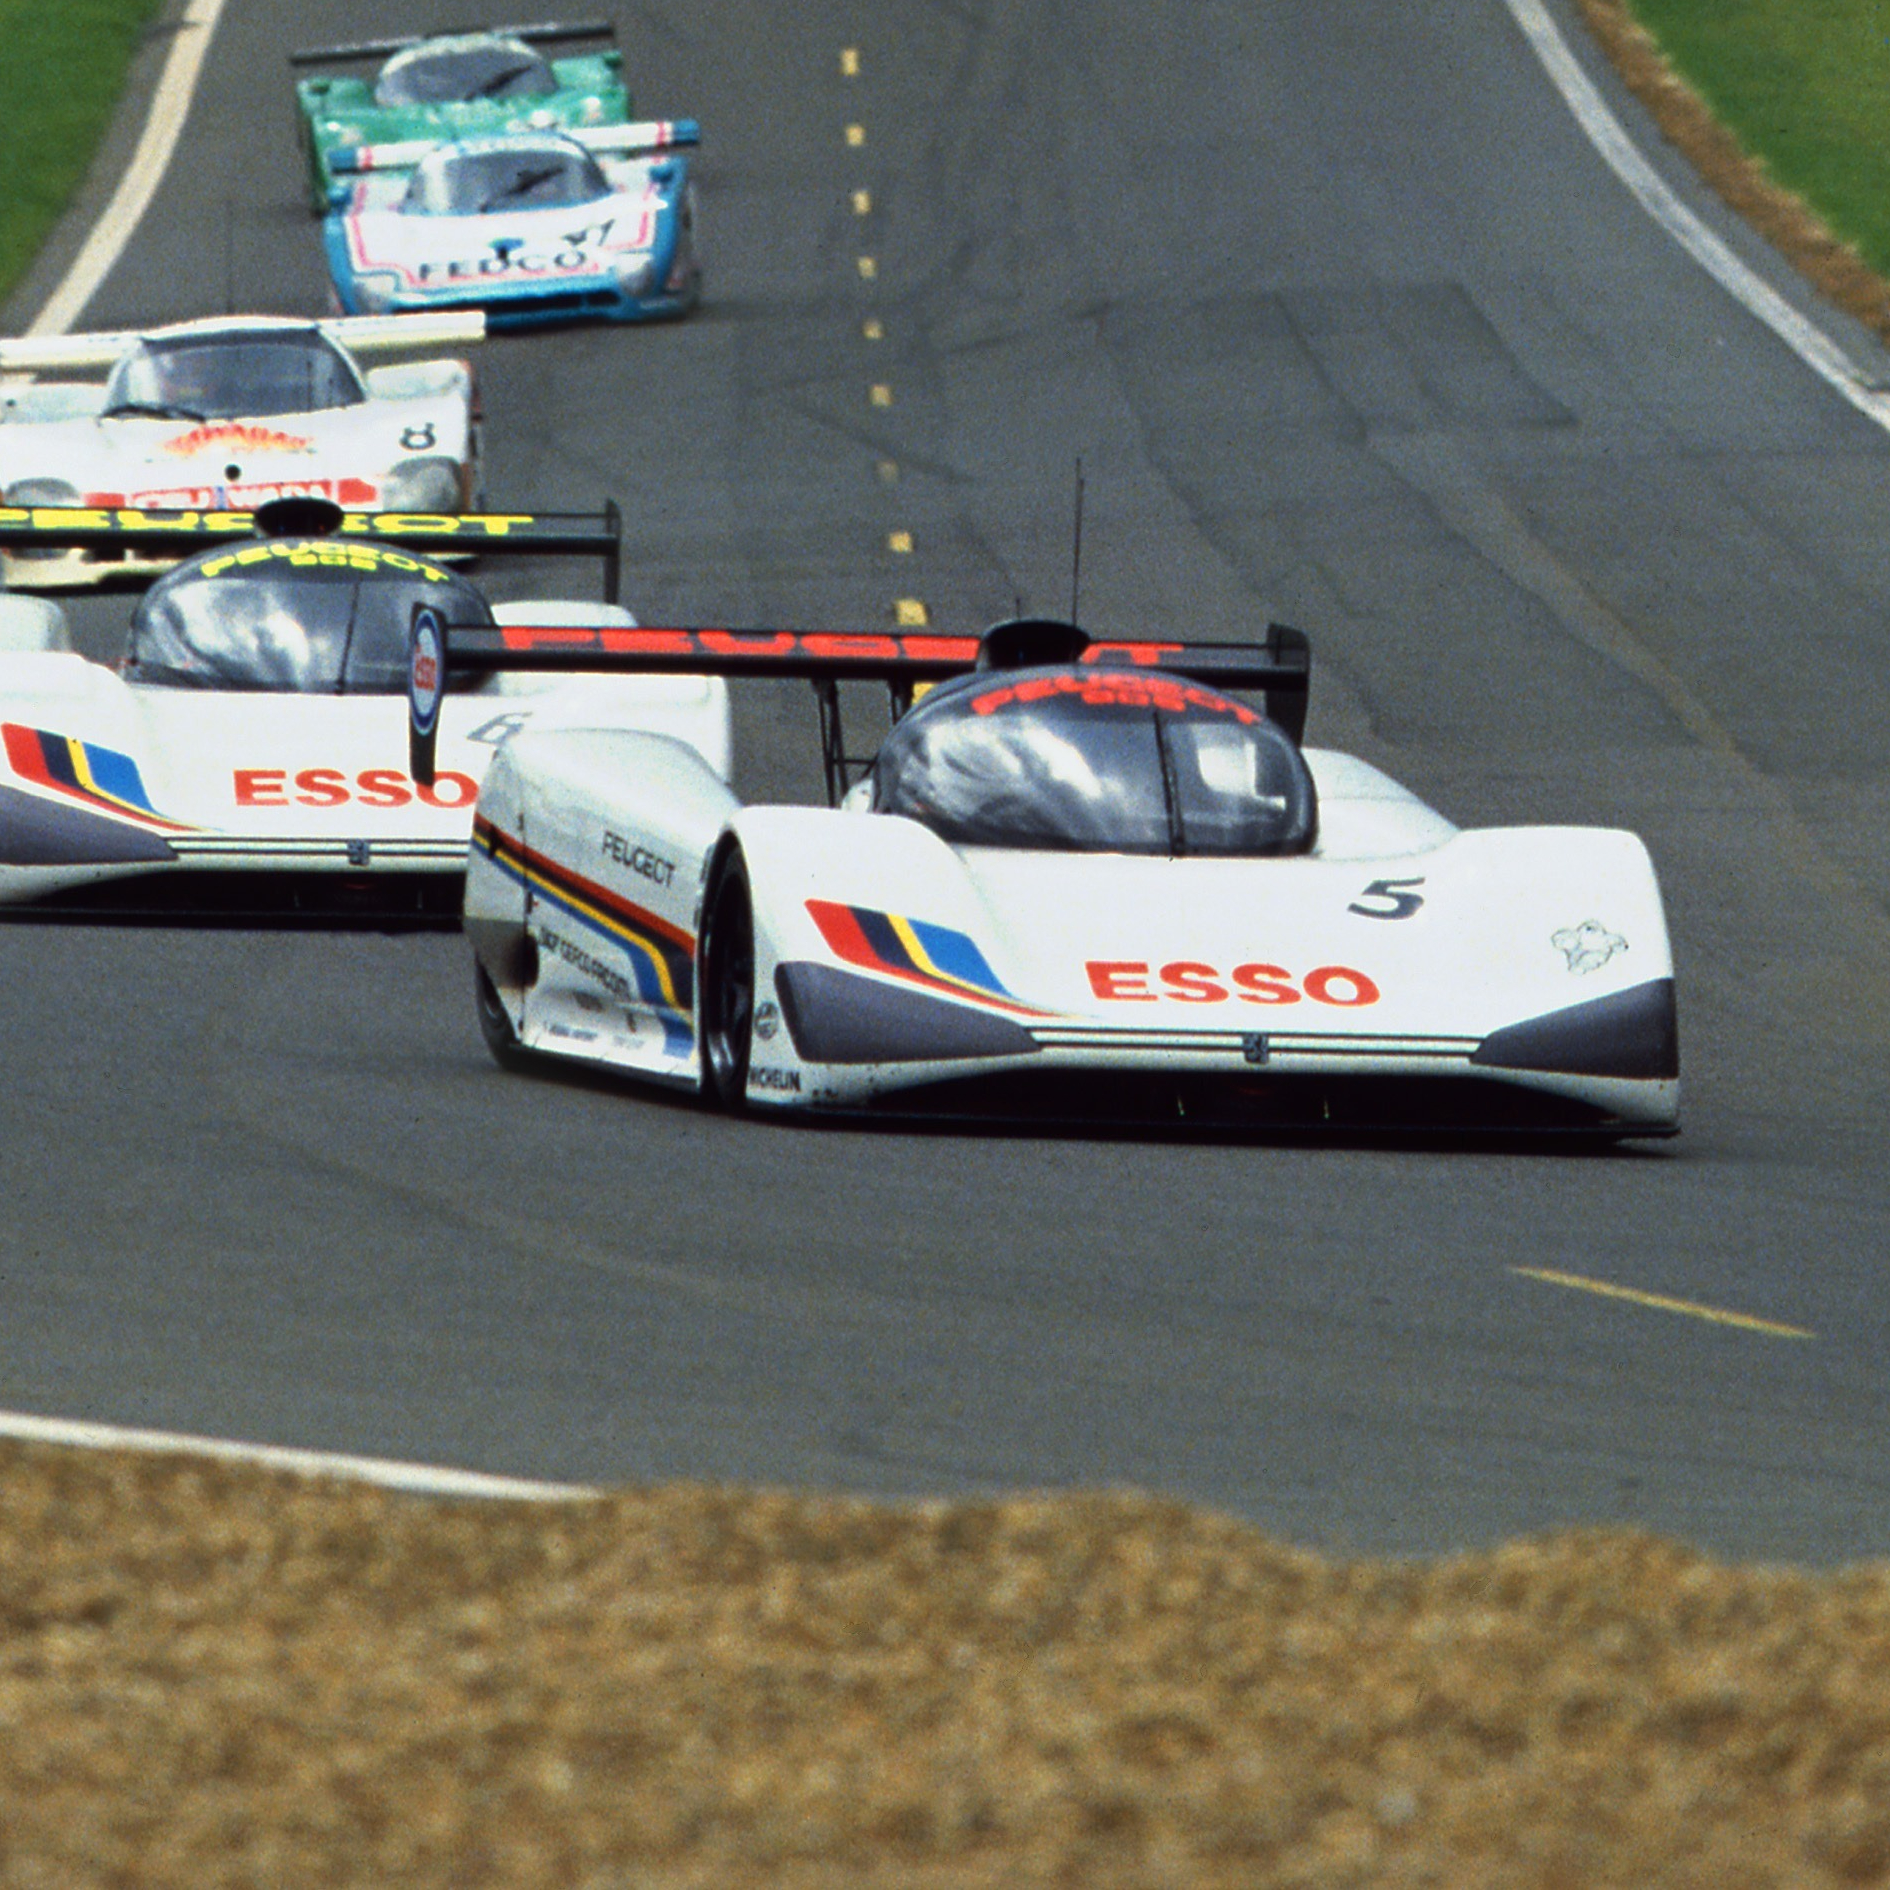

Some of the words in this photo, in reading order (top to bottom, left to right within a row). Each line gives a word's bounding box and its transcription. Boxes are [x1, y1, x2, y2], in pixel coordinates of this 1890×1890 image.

[232, 768, 481, 809] ESSO
[1346, 876, 1426, 921] 5
[1084, 960, 1382, 1007] ESSO
